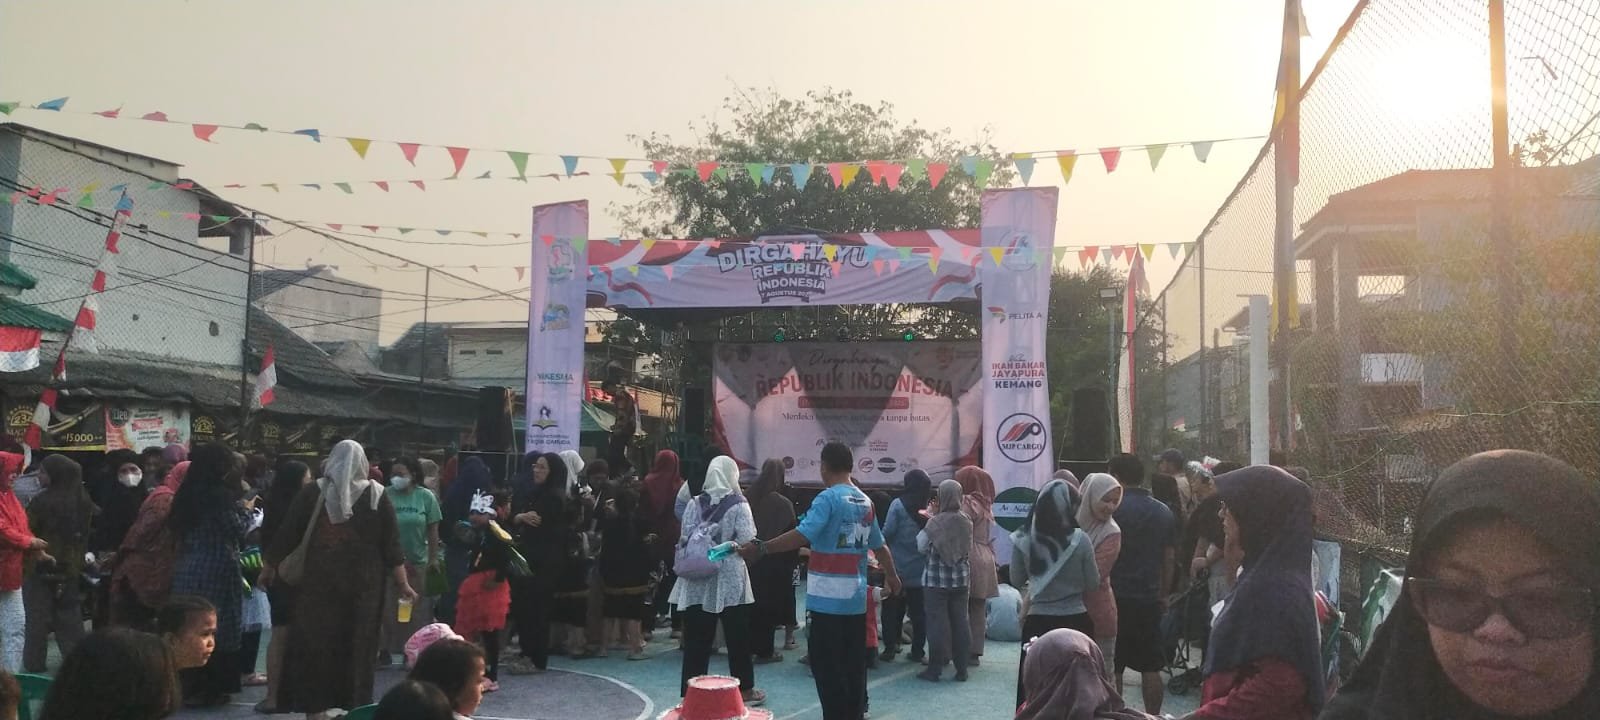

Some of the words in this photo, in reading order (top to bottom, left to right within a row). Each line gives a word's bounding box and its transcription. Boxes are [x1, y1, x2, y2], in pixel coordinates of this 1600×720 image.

[718, 242, 870, 272] DIRGAHAYU
[752, 262, 832, 279] REPUBLIK
[759, 277, 825, 290] INDONESIA
[992, 370, 1045, 378] JAYAPURA
[755, 372, 845, 397] REPUBLIK
[852, 372, 953, 398] INDONESIA
[995, 380, 1042, 389] KEMANG
